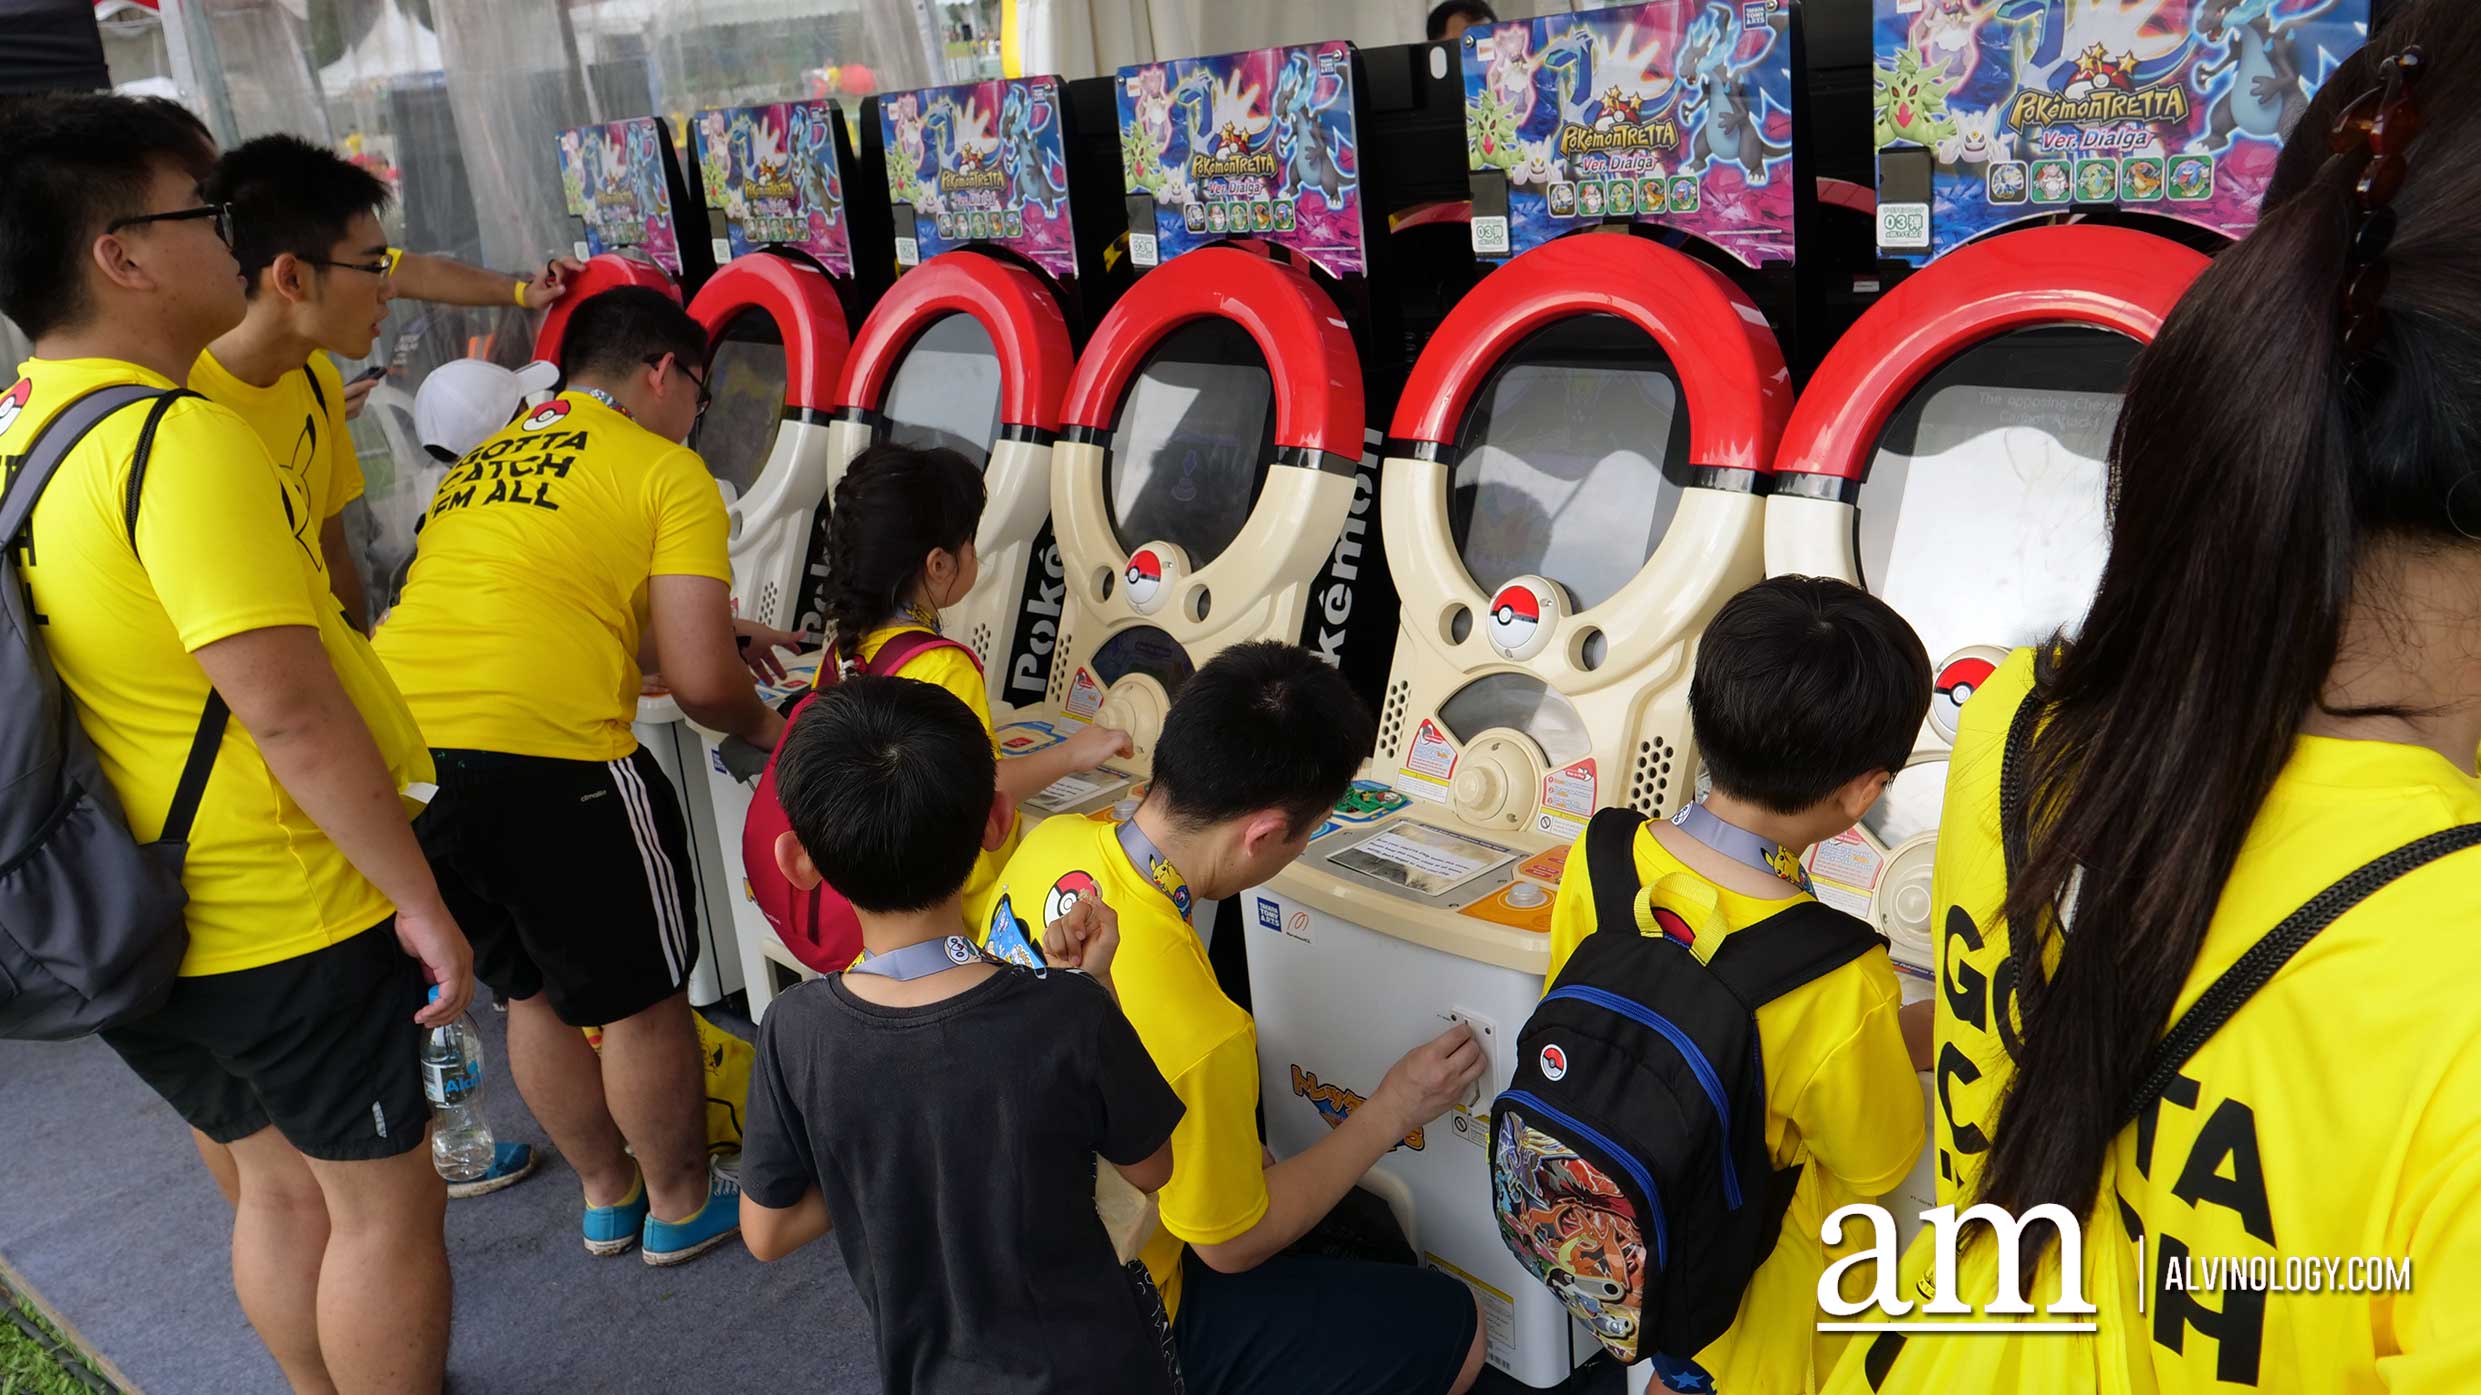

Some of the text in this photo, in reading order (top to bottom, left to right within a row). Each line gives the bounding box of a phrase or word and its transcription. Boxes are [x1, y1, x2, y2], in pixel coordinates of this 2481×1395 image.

[2043, 128, 2149, 149] Ver. Dialga
[1583, 155, 1653, 172] Ver. Dialga
[456, 431, 588, 467] GOTTA
[438, 453, 576, 495] CATCH
[482, 479, 559, 512] ALL
[1309, 427, 1384, 670] kémon
[1012, 543, 1066, 692] Poké
